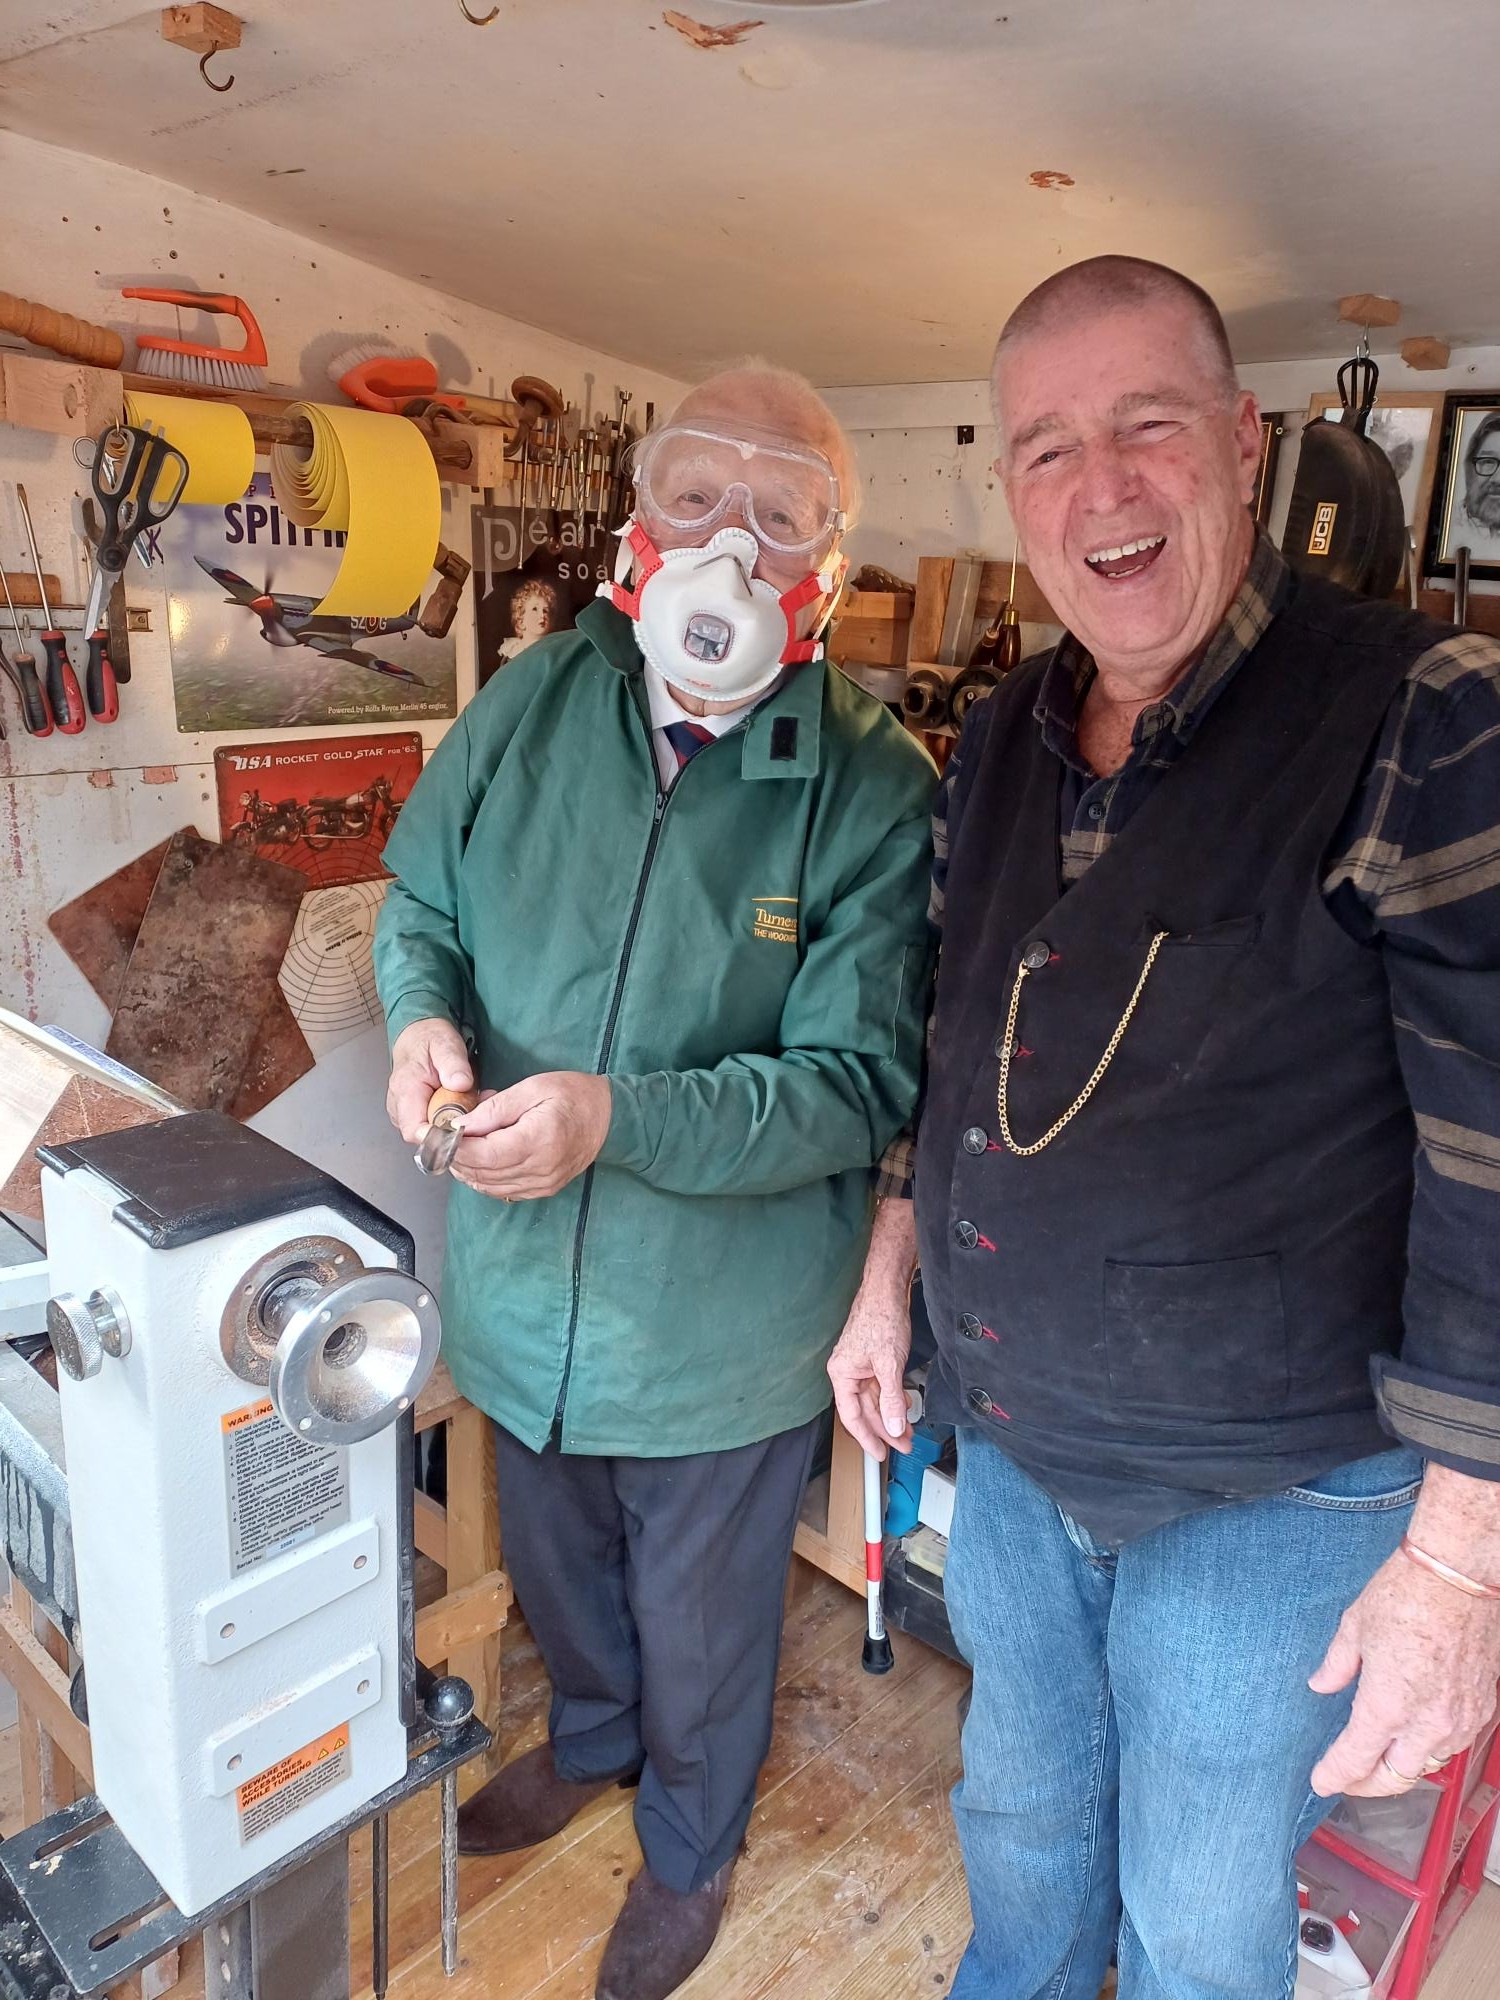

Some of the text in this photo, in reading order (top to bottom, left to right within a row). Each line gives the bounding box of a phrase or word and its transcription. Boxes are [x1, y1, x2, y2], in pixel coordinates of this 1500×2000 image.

[1312, 507, 1333, 550] JCB
[482, 517, 606, 600] pear
[558, 562, 609, 580] soa
[328, 706, 355, 714] Powered
[356, 705, 364, 715] by
[382, 704, 399, 713] Royce
[400, 703, 418, 711] Merlin
[420, 702, 427, 710] 45
[229, 755, 272, 770] BSA
[275, 753, 319, 766] ROCKET
[323, 751, 352, 761] GOLD
[354, 748, 384, 760] STAR
[753, 927, 768, 938] THE
[227, 1404, 273, 1428] WARING
[241, 1758, 292, 1793] BEWARE OF
[241, 1759, 301, 1800] ACCESSORIES
[242, 1760, 311, 1807] WHILE TURNING
